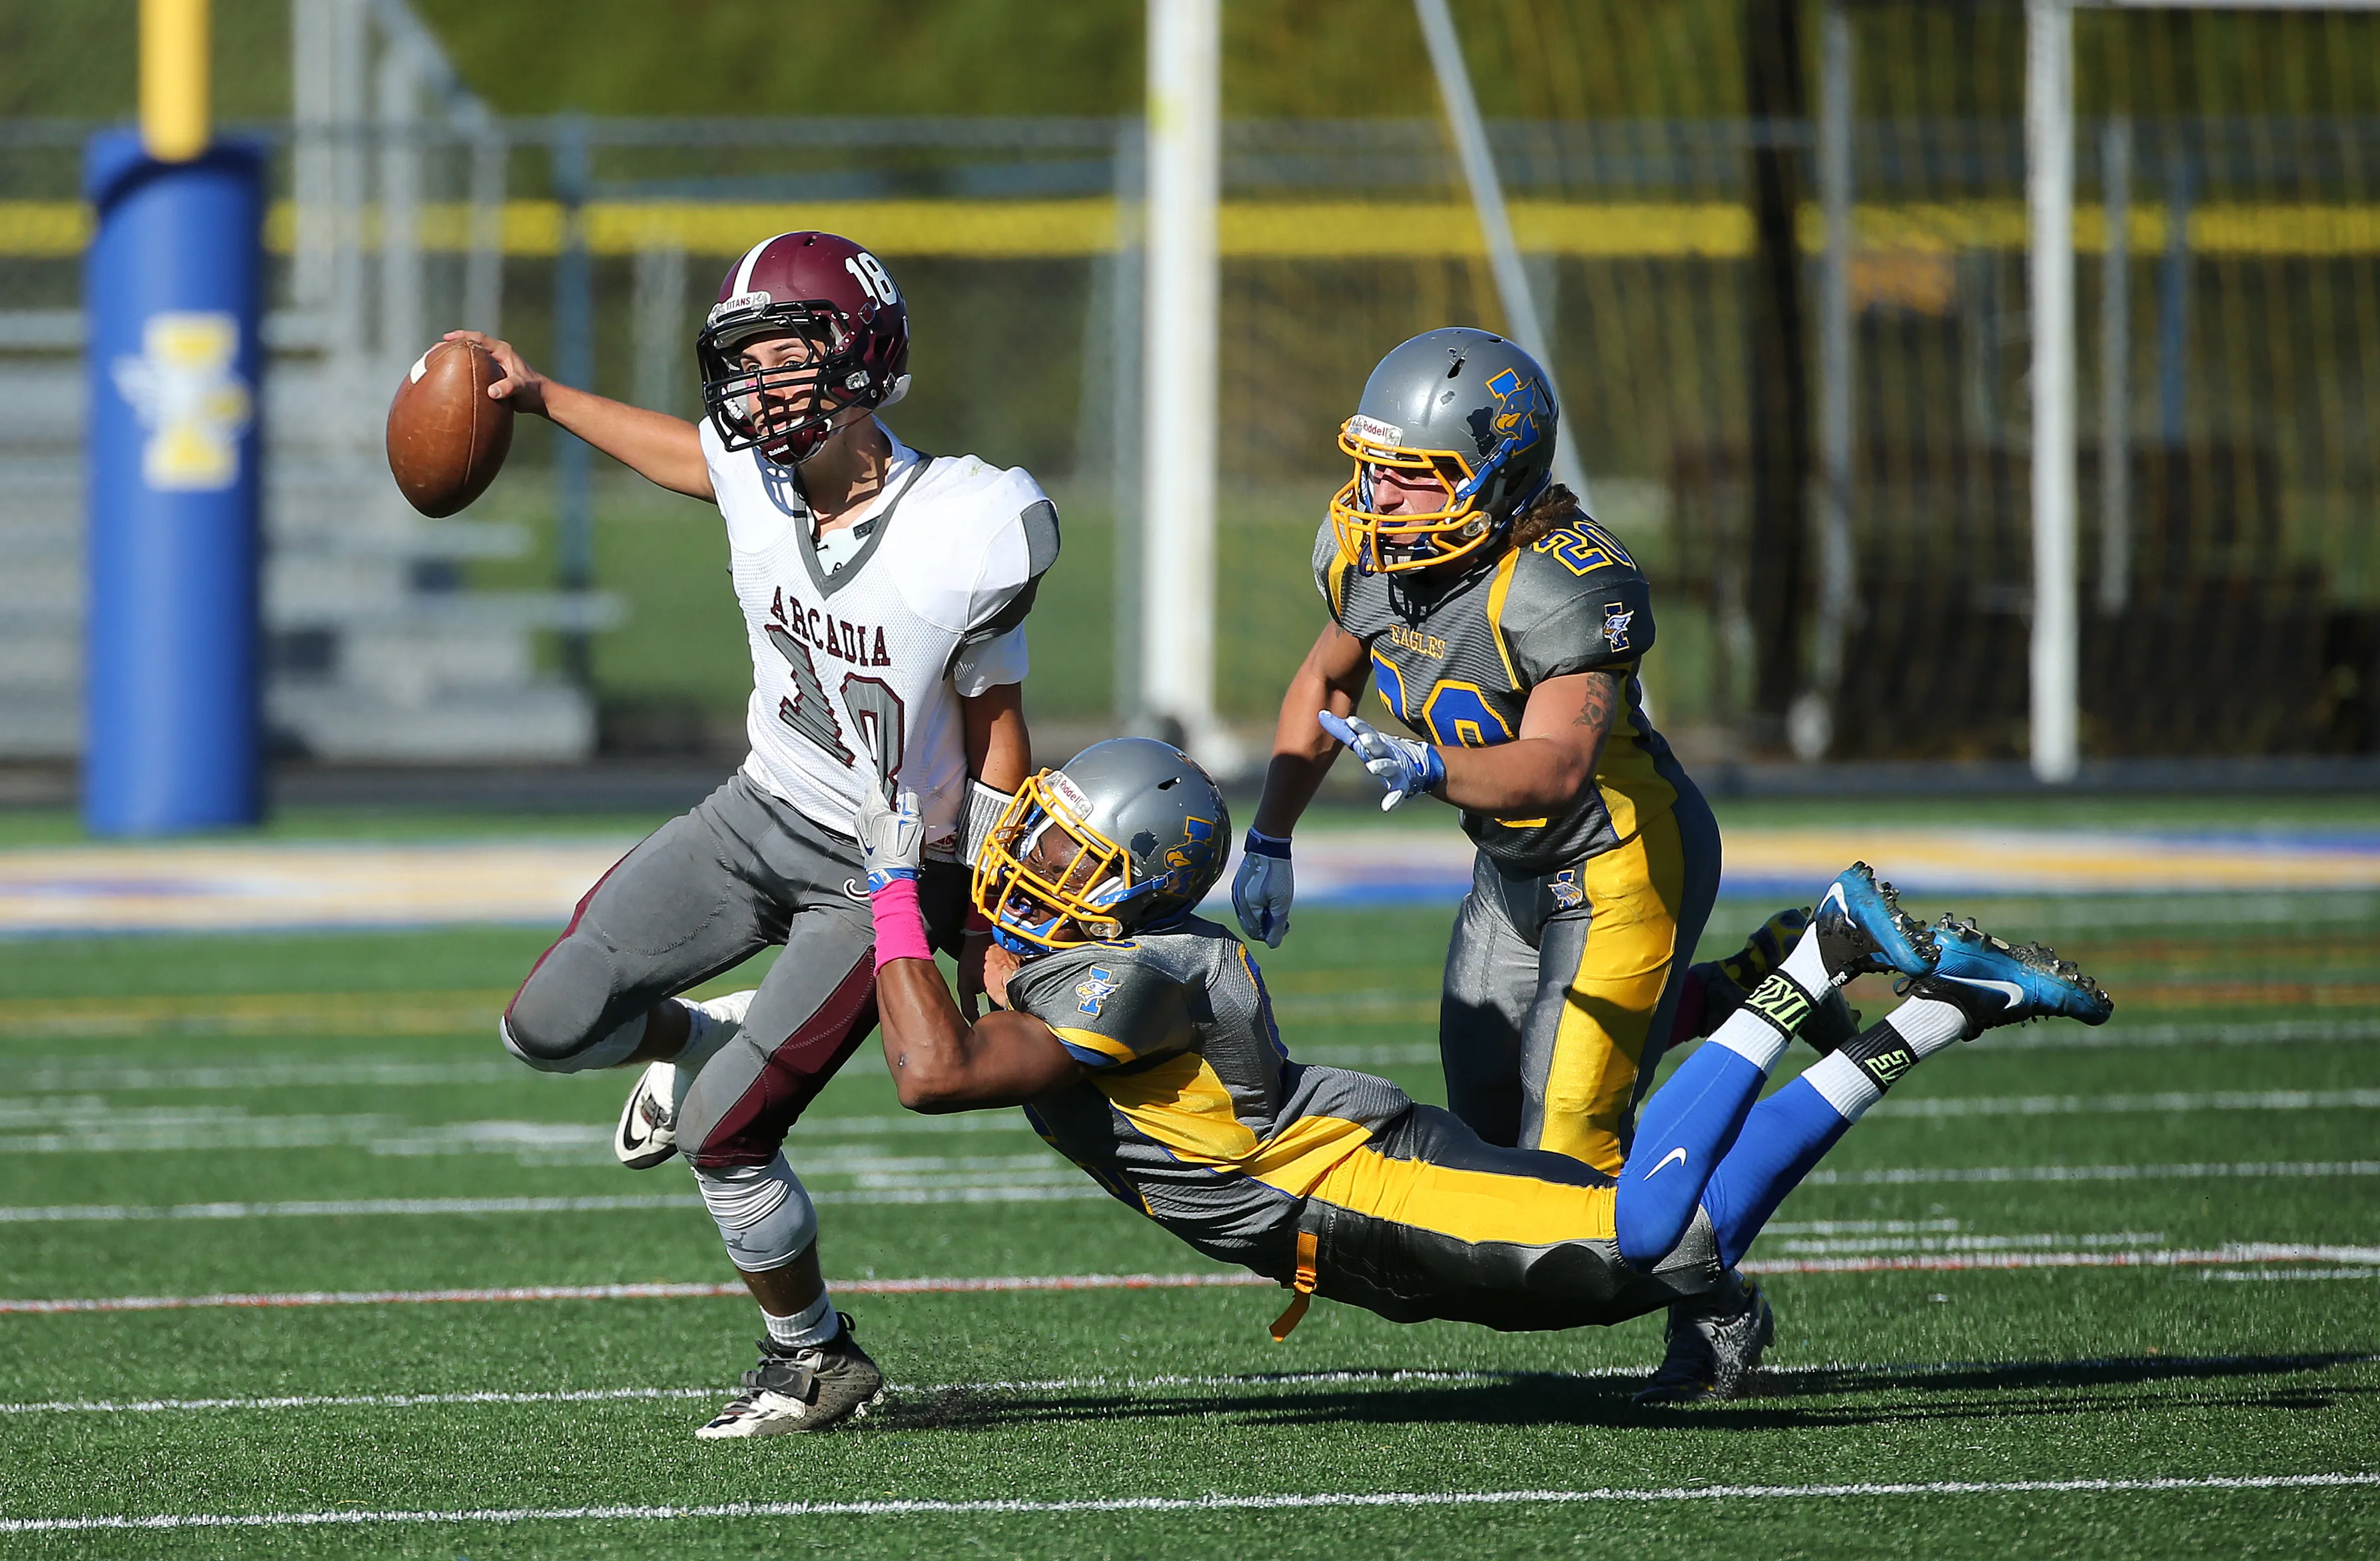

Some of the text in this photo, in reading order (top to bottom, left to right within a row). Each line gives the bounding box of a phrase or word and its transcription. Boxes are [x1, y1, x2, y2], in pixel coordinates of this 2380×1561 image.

[726, 296, 751, 310] TITANS
[845, 252, 897, 311] 18
[770, 586, 891, 667] ARCADIA
[1388, 624, 1446, 660] EAGLES
